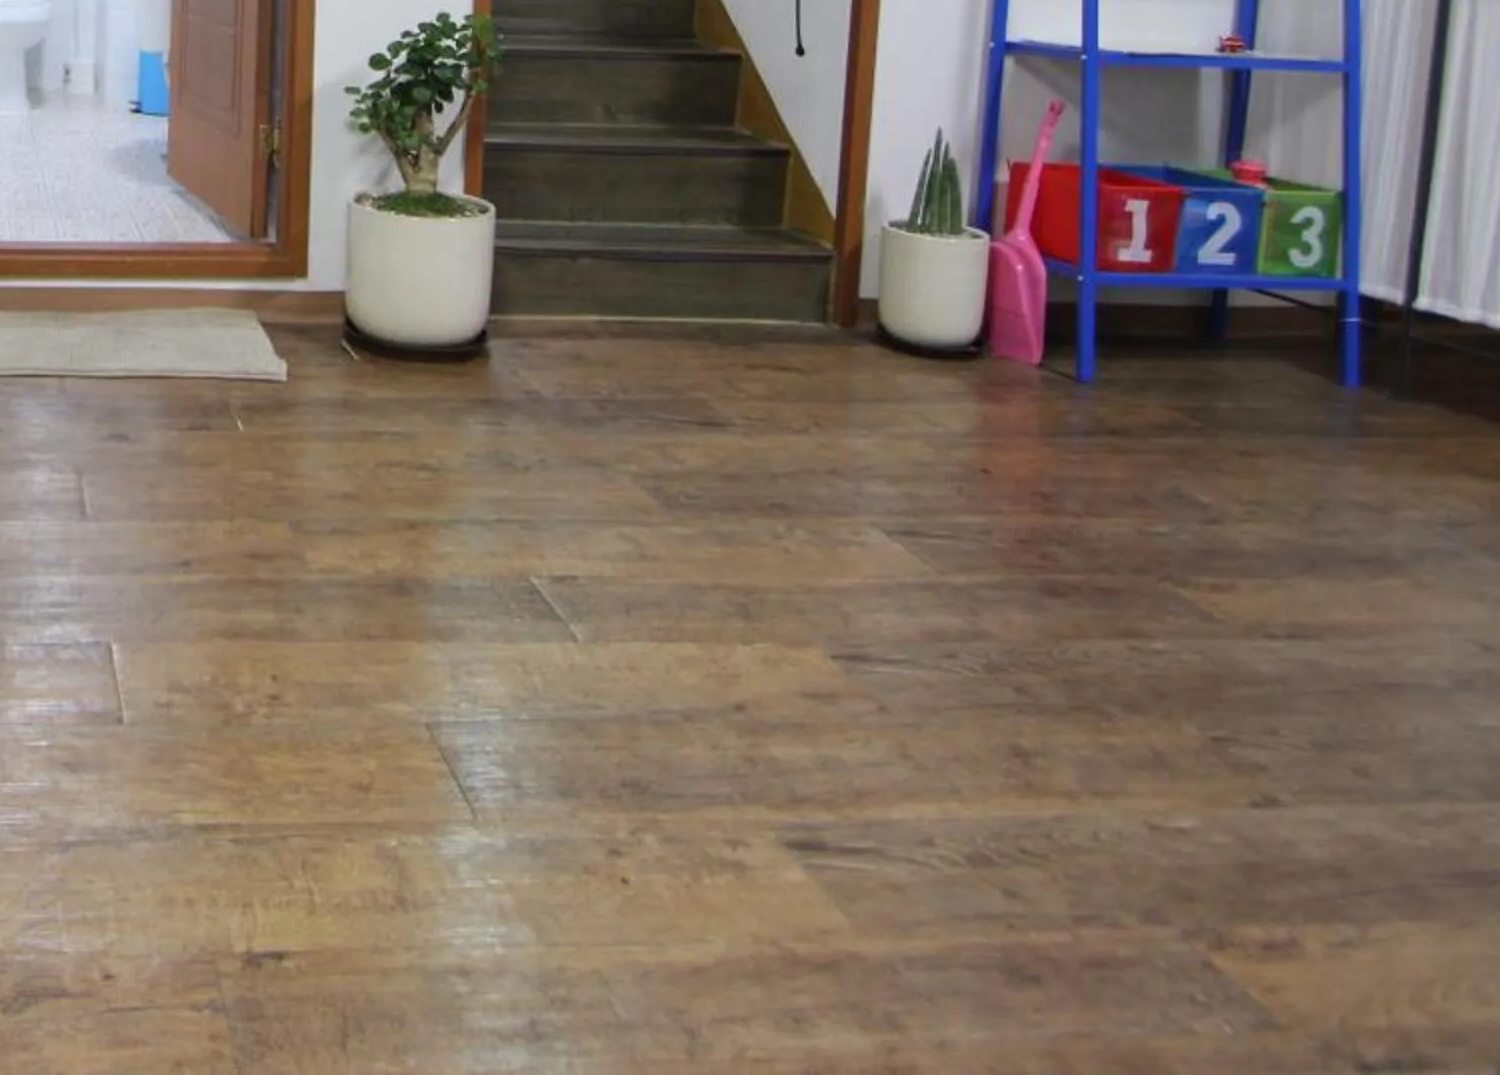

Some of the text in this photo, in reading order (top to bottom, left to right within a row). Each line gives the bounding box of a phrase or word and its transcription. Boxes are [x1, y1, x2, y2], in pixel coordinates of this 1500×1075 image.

[1117, 199, 1153, 264] 1
[1197, 201, 1242, 265] 2
[1287, 206, 1325, 269] 3
